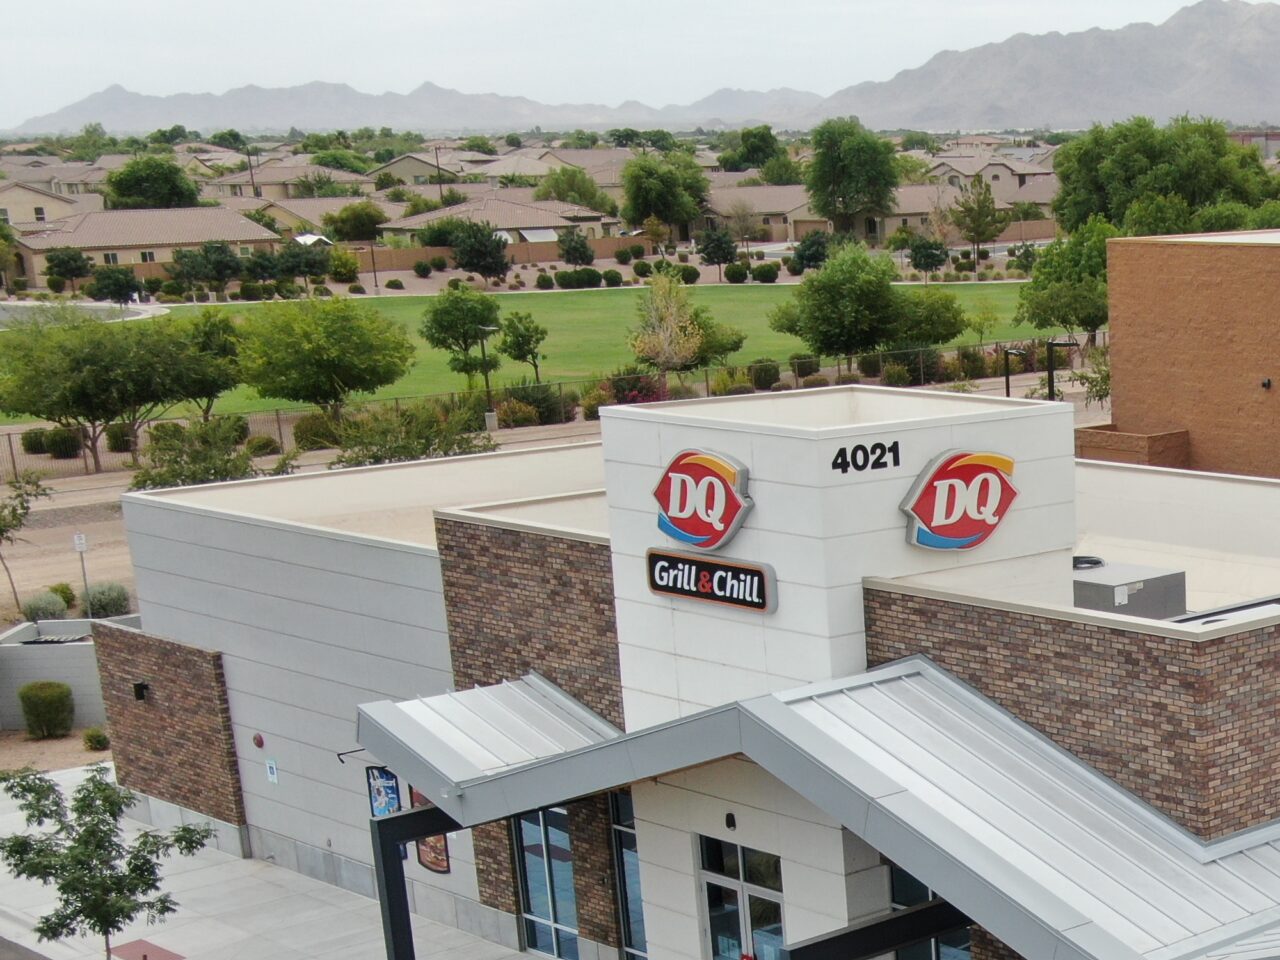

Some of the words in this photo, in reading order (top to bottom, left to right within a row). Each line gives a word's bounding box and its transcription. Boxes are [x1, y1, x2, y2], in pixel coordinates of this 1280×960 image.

[832, 441, 900, 474] 4021
[668, 472, 725, 532] DQ
[930, 472, 1002, 527] DQ
